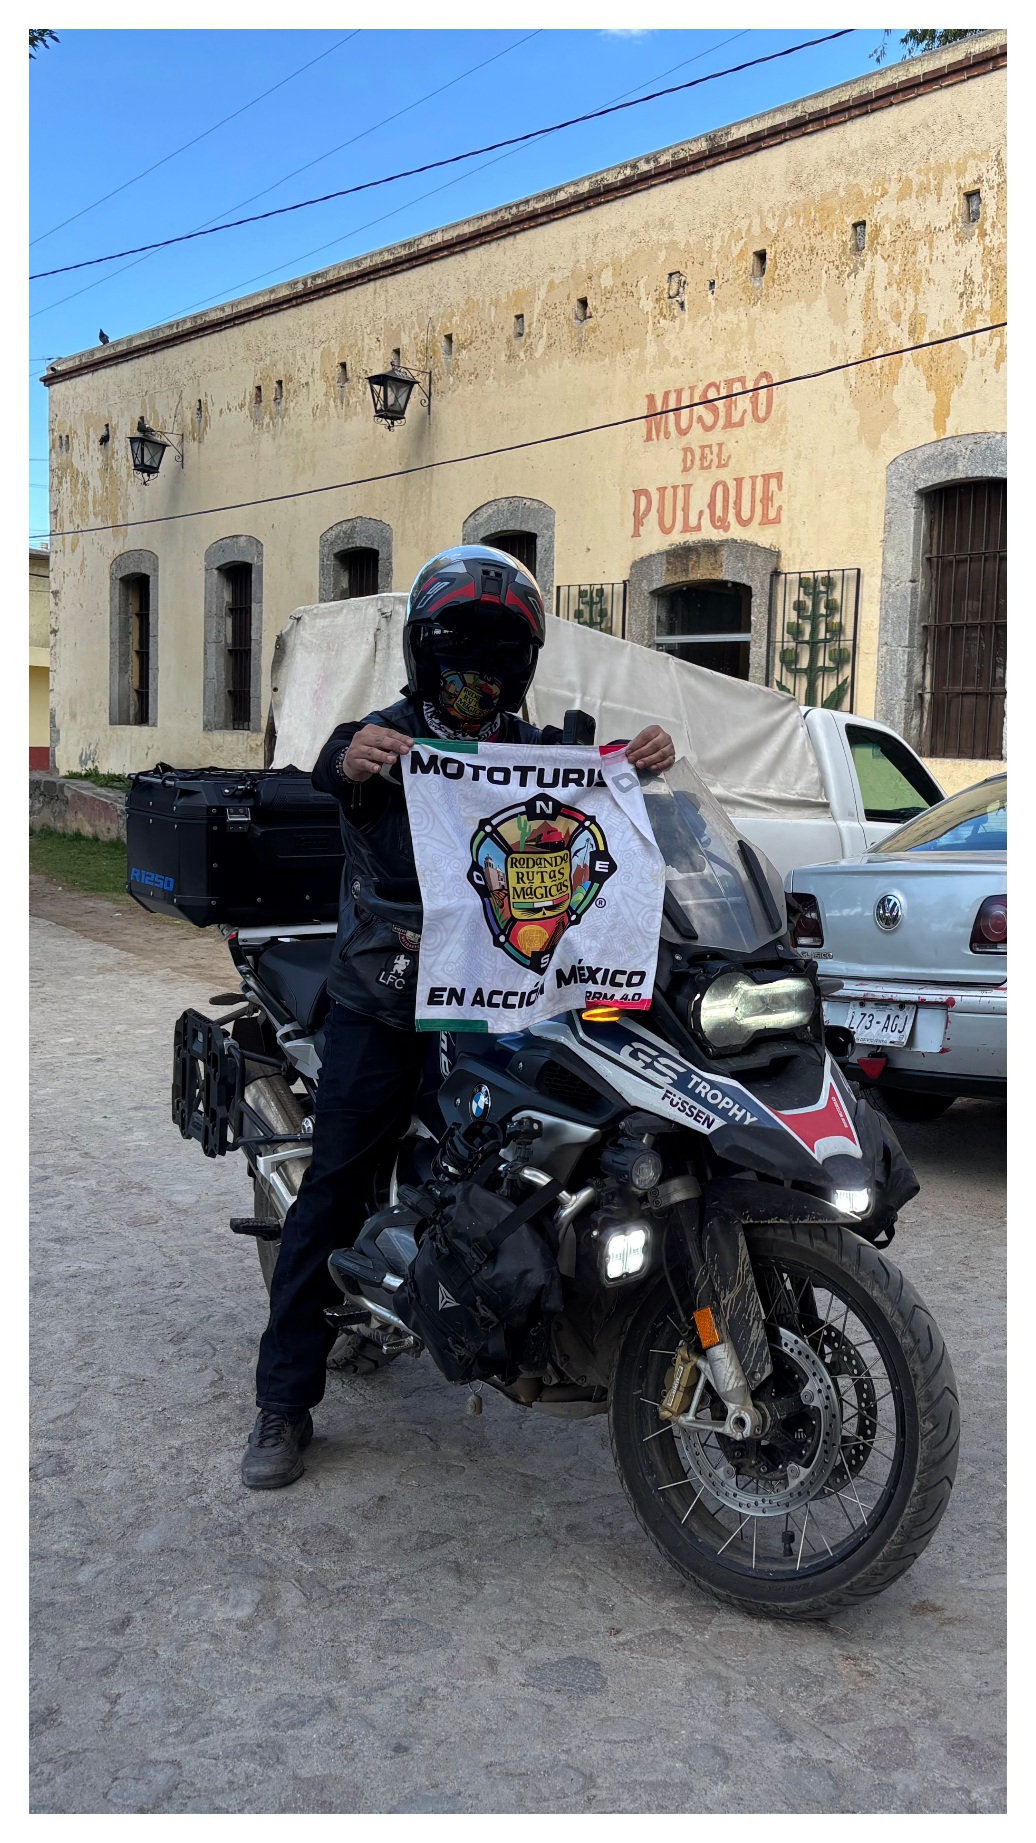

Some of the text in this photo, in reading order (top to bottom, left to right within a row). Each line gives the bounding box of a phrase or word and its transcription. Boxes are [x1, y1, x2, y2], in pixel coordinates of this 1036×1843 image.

[643, 370, 774, 443] MUSEO
[681, 442, 732, 473] DEL
[631, 471, 784, 538] PULQUE
[535, 801, 553, 815] N
[131, 867, 175, 892] R1250
[595, 860, 610, 873] E
[379, 971, 406, 990] LFC
[427, 987, 466, 1006] EN
[555, 958, 647, 989] MÉXICO
[619, 992, 642, 1002] 4.0
[848, 1010, 909, 1034] L73-AGJ
[619, 1041, 759, 1126] GS TROPHY
[661, 1089, 716, 1130] FÜSSEN
